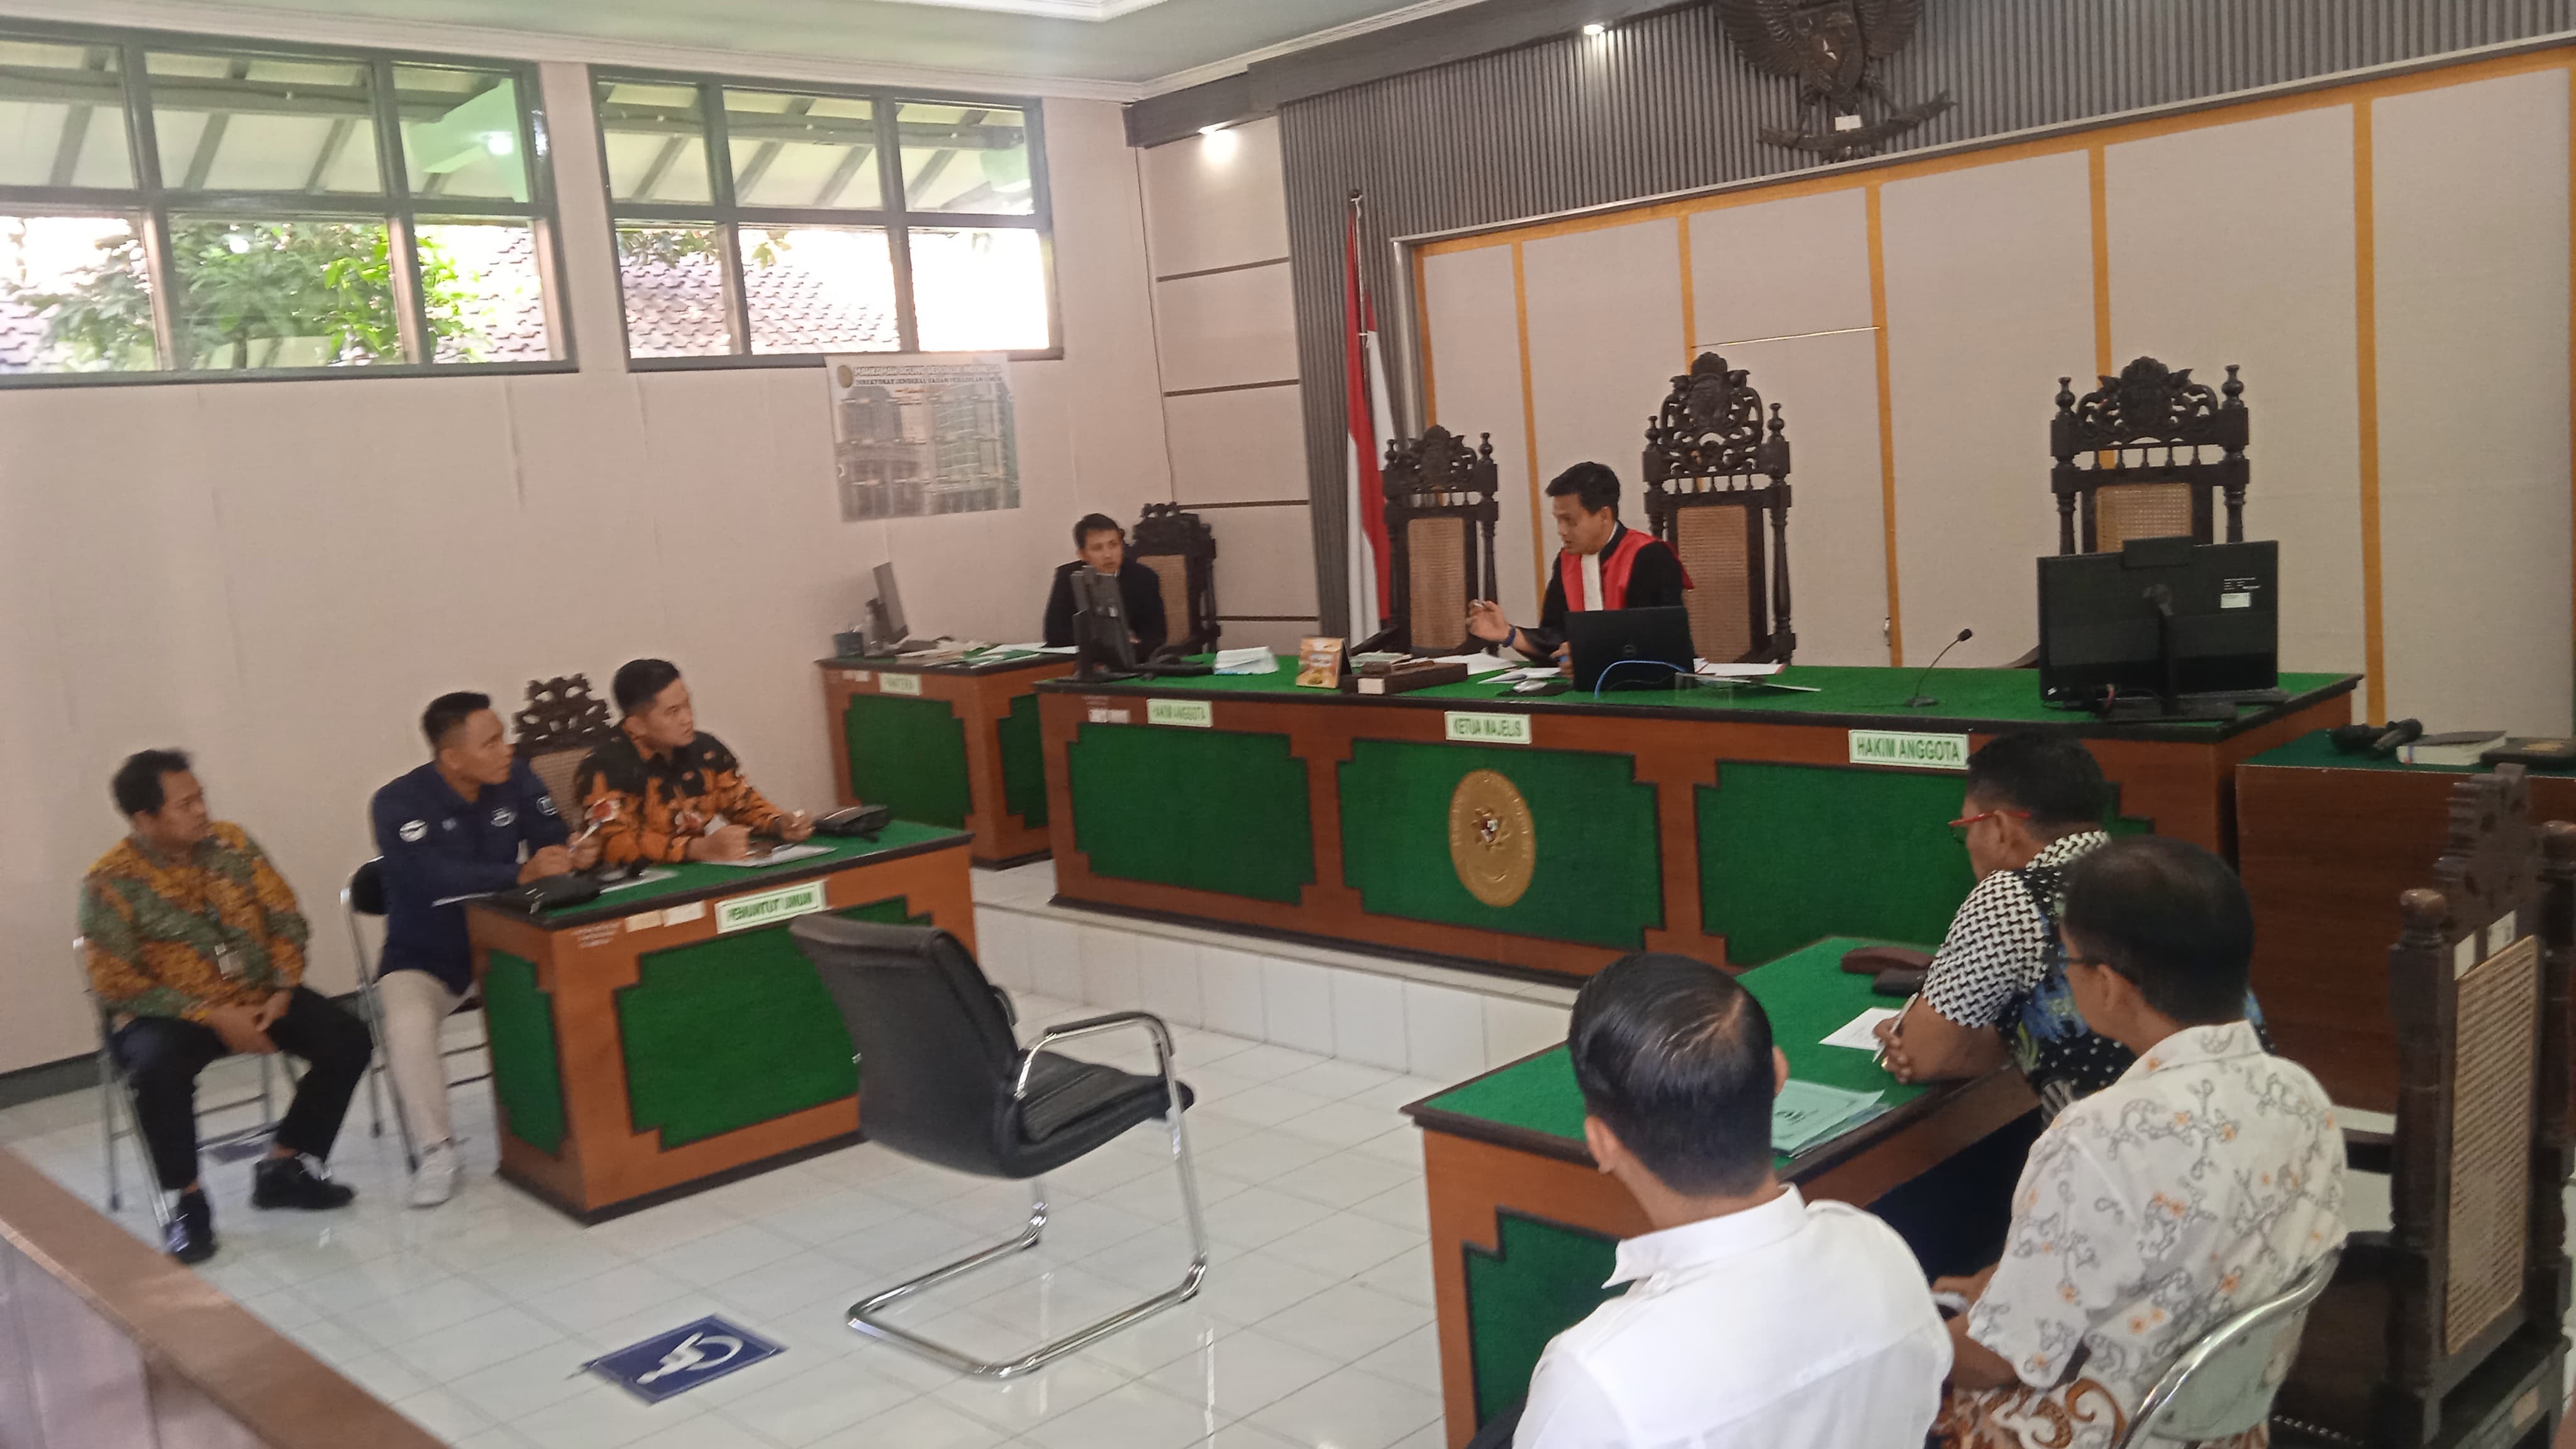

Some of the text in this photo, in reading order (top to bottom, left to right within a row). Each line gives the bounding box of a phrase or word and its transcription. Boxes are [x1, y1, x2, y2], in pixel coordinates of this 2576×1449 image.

[1174, 706, 1206, 721] ANGGOTA
[1453, 718, 1521, 737] KETUA MAJELIS
[1857, 737, 1960, 762] HAKIM ANGGOTA
[727, 891, 813, 923] PENUNTUT UMUM
